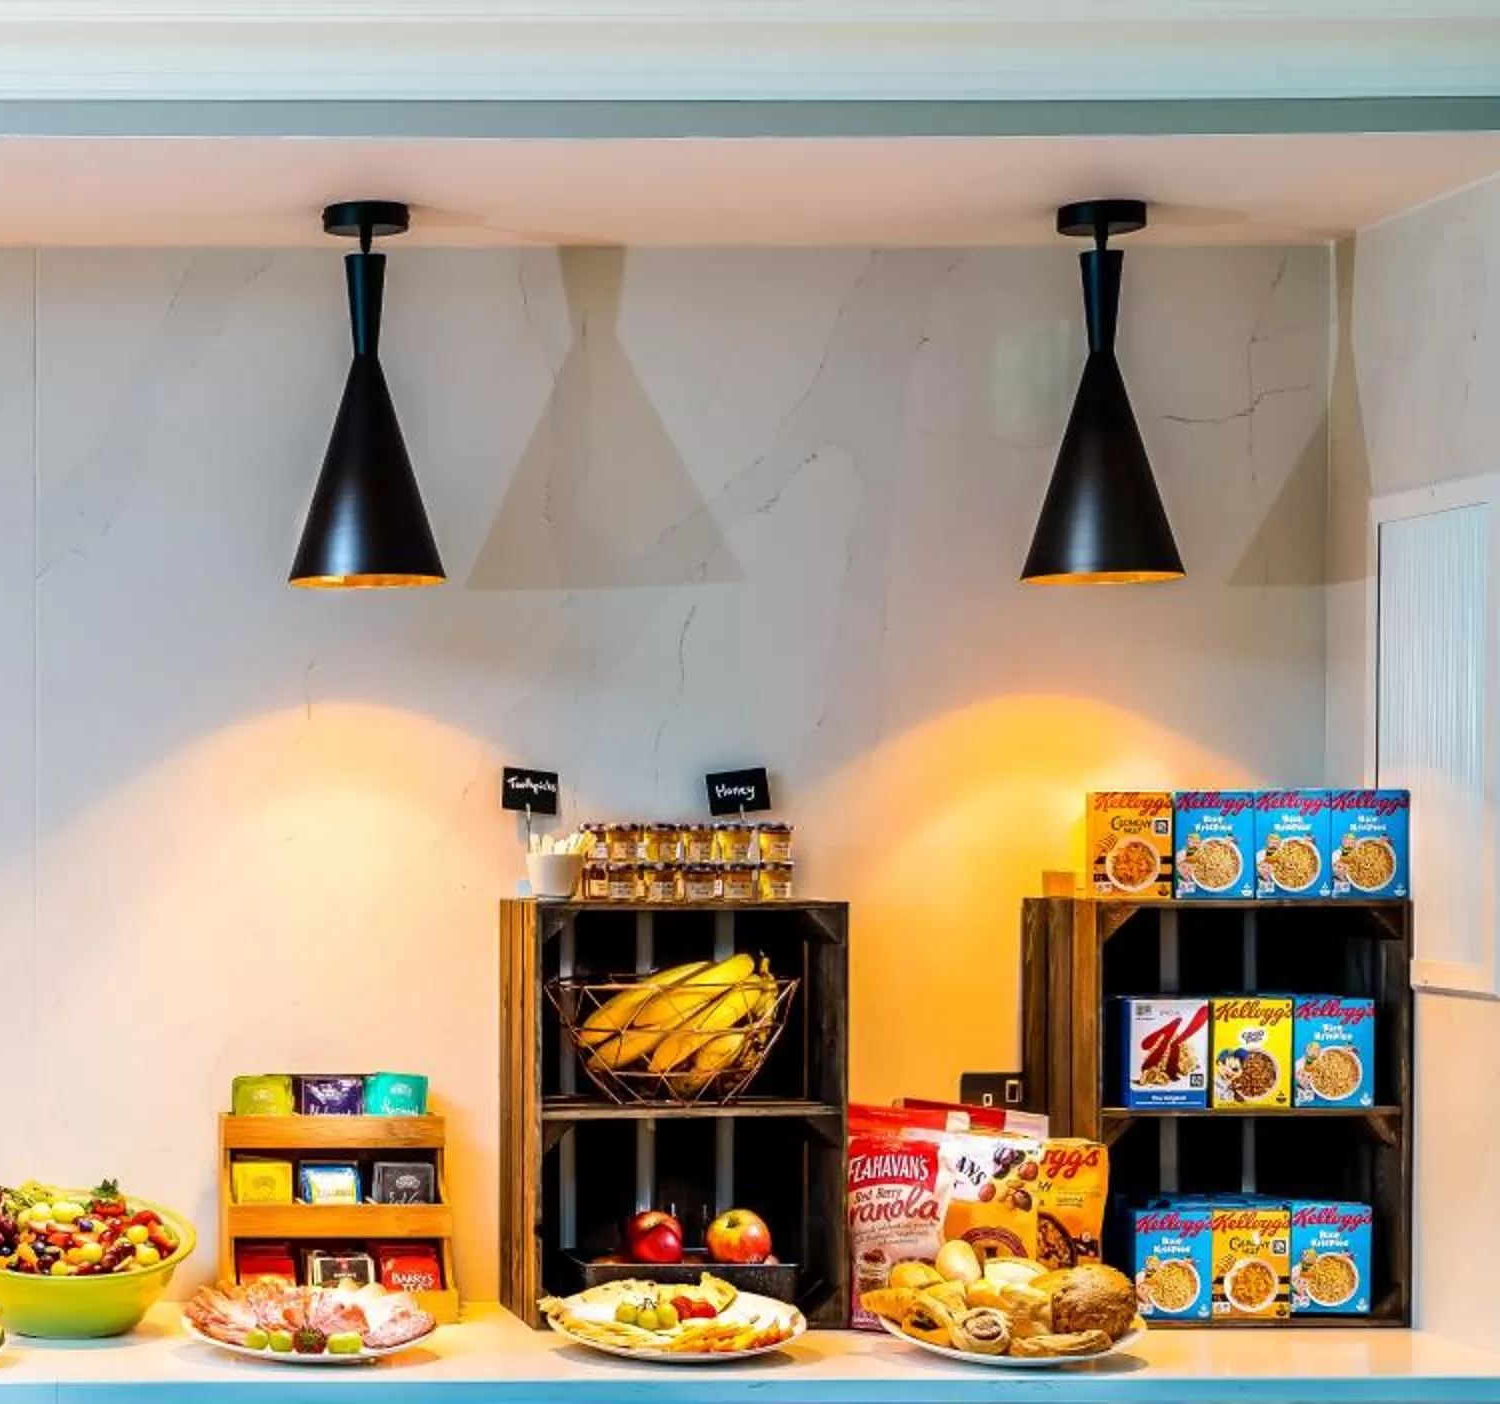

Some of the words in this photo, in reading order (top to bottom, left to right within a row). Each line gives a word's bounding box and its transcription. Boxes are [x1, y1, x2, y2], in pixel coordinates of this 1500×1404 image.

[715, 784, 755, 801] Honey
[1215, 999, 1292, 1026] Kellogg's
[1296, 999, 1376, 1025] Kellogg's
[848, 1154, 930, 1183] FLAHAVAN'S
[849, 1186, 940, 1227] ranola
[1292, 1205, 1373, 1232] Kellogg's
[1135, 1211, 1212, 1238] Kellogg's
[1211, 1212, 1290, 1236] Kellogg's
